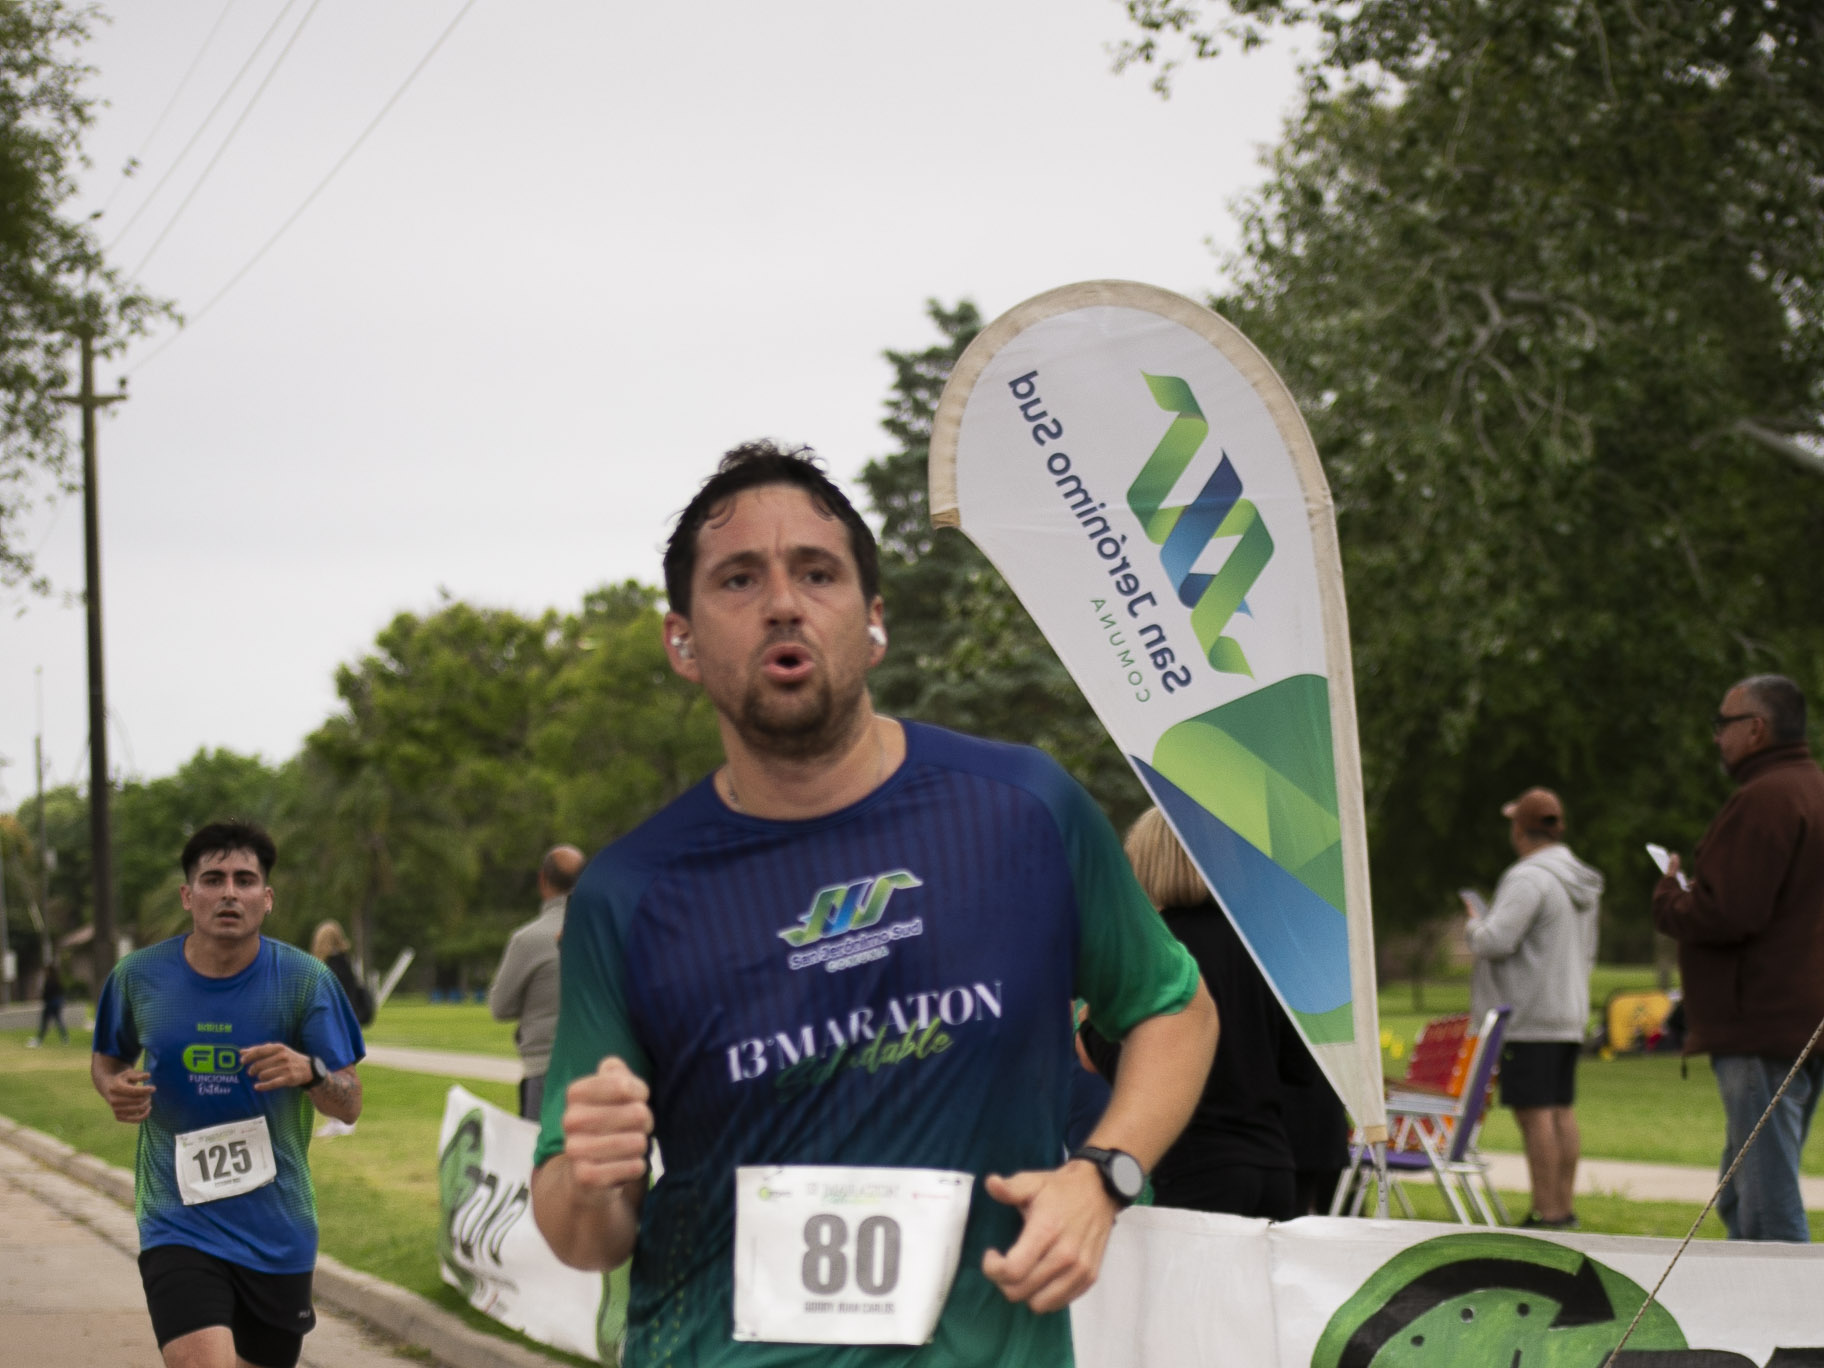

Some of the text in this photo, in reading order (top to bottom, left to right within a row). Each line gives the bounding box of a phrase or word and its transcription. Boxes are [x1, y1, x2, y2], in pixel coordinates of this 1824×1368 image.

[888, 917, 924, 941] Sud
[774, 980, 1003, 1070] MARATON
[189, 1074, 239, 1084] FUNCIONAL
[192, 1140, 253, 1183] 125
[802, 1213, 902, 1298] 80
